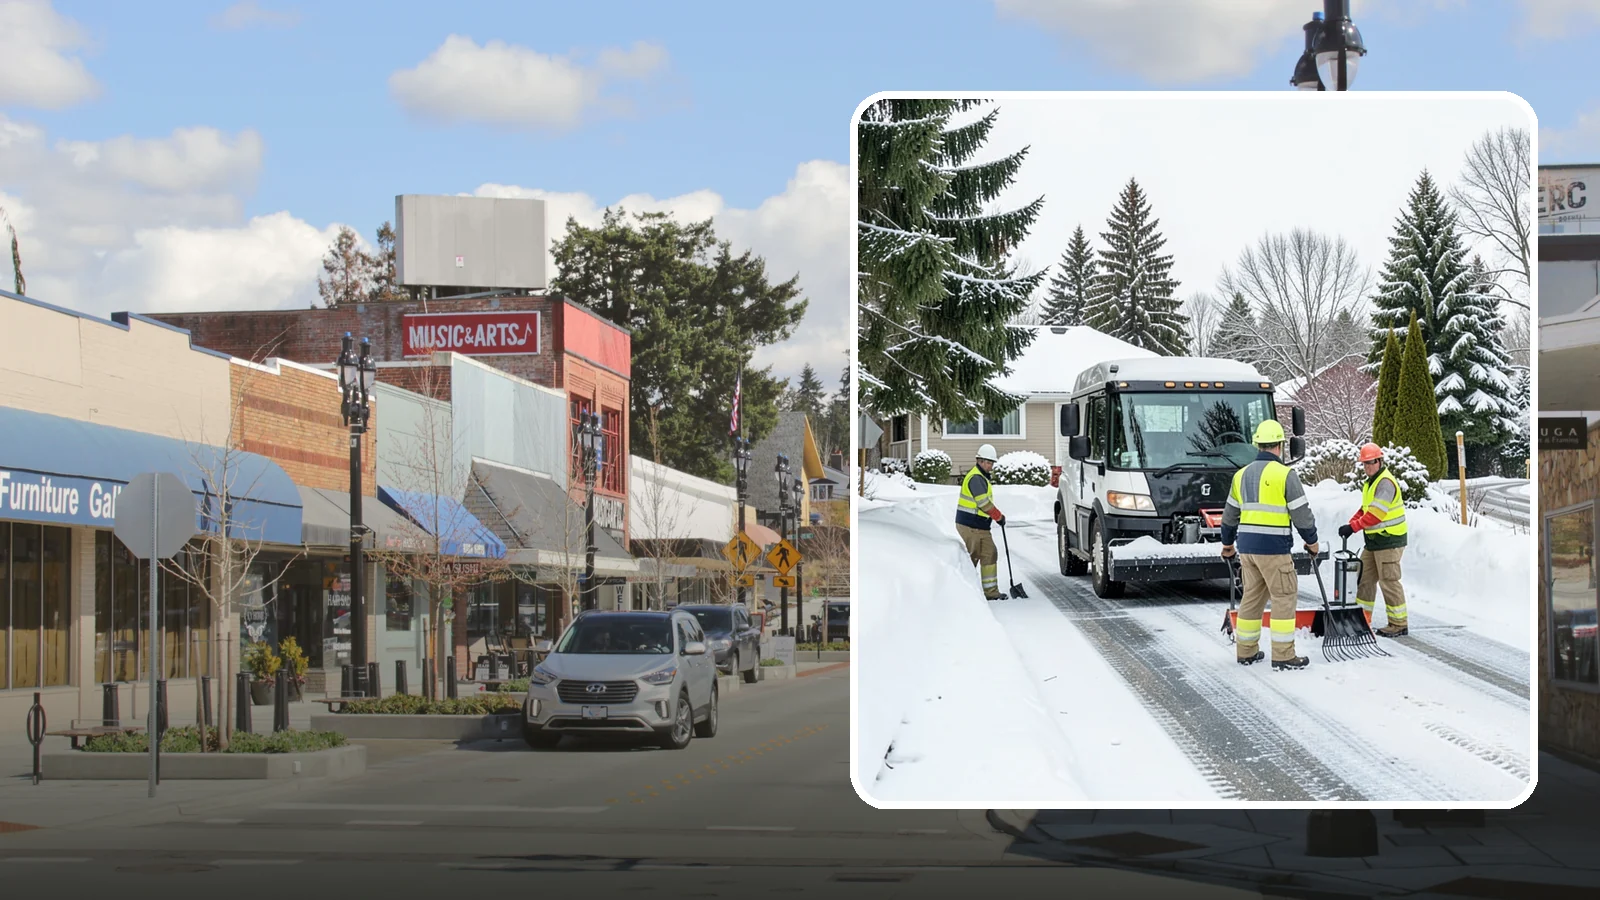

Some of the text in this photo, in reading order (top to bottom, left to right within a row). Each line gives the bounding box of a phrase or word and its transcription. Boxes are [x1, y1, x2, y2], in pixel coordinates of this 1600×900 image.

[408, 322, 520, 349] MUSIC&ARTS
[1540, 427, 1578, 437] UGA
[0, 471, 80, 515] Furniture
